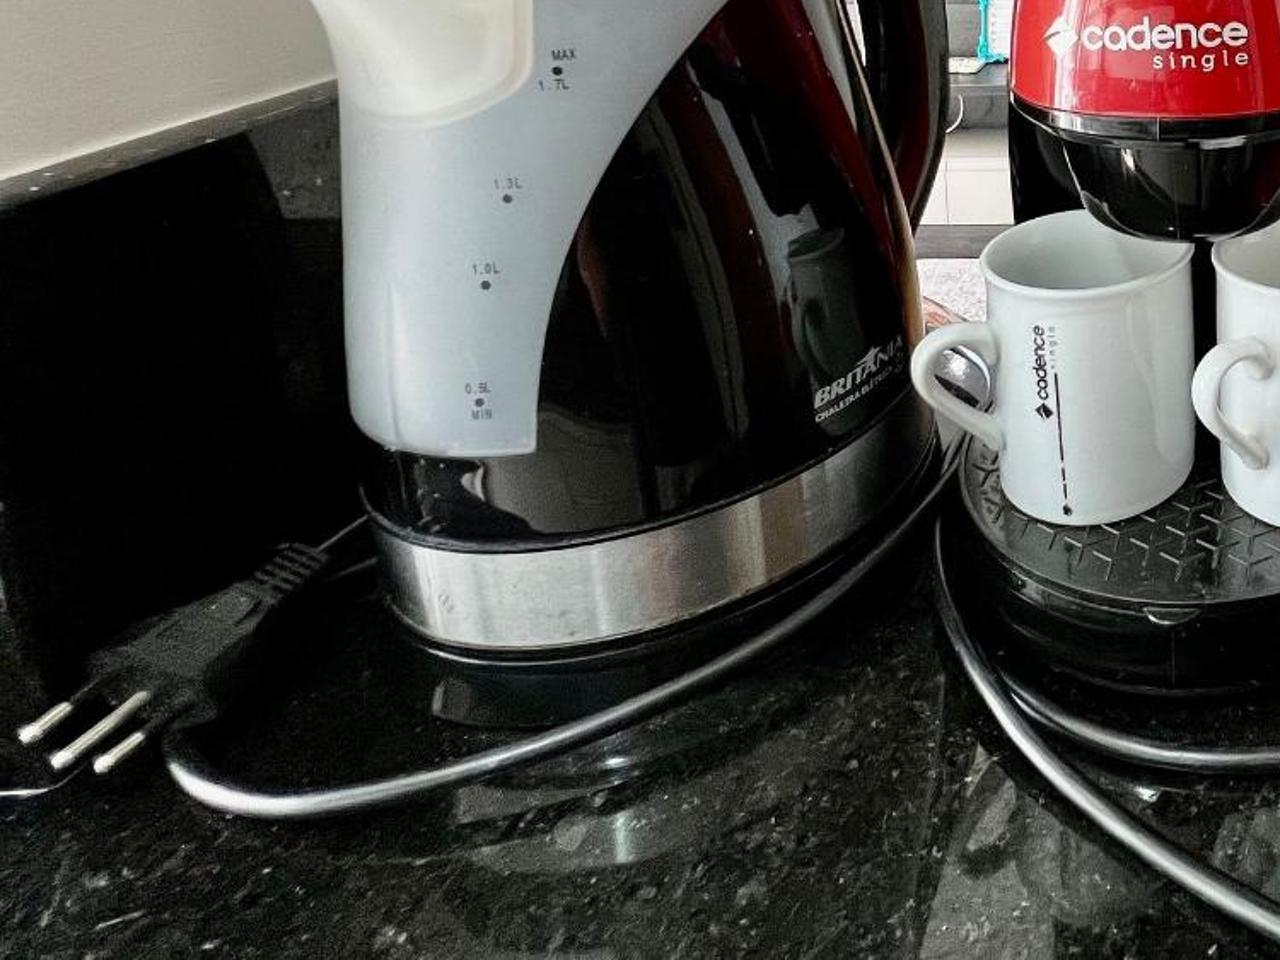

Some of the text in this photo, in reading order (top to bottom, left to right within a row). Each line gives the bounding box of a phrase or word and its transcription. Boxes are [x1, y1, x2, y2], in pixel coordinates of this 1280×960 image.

[1081, 16, 1249, 51] cadence
[551, 48, 577, 61] MAX
[1152, 50, 1249, 72] single
[471, 261, 501, 276] 1.0L
[1032, 324, 1049, 401] cadence
[471, 408, 493, 420] MIN
